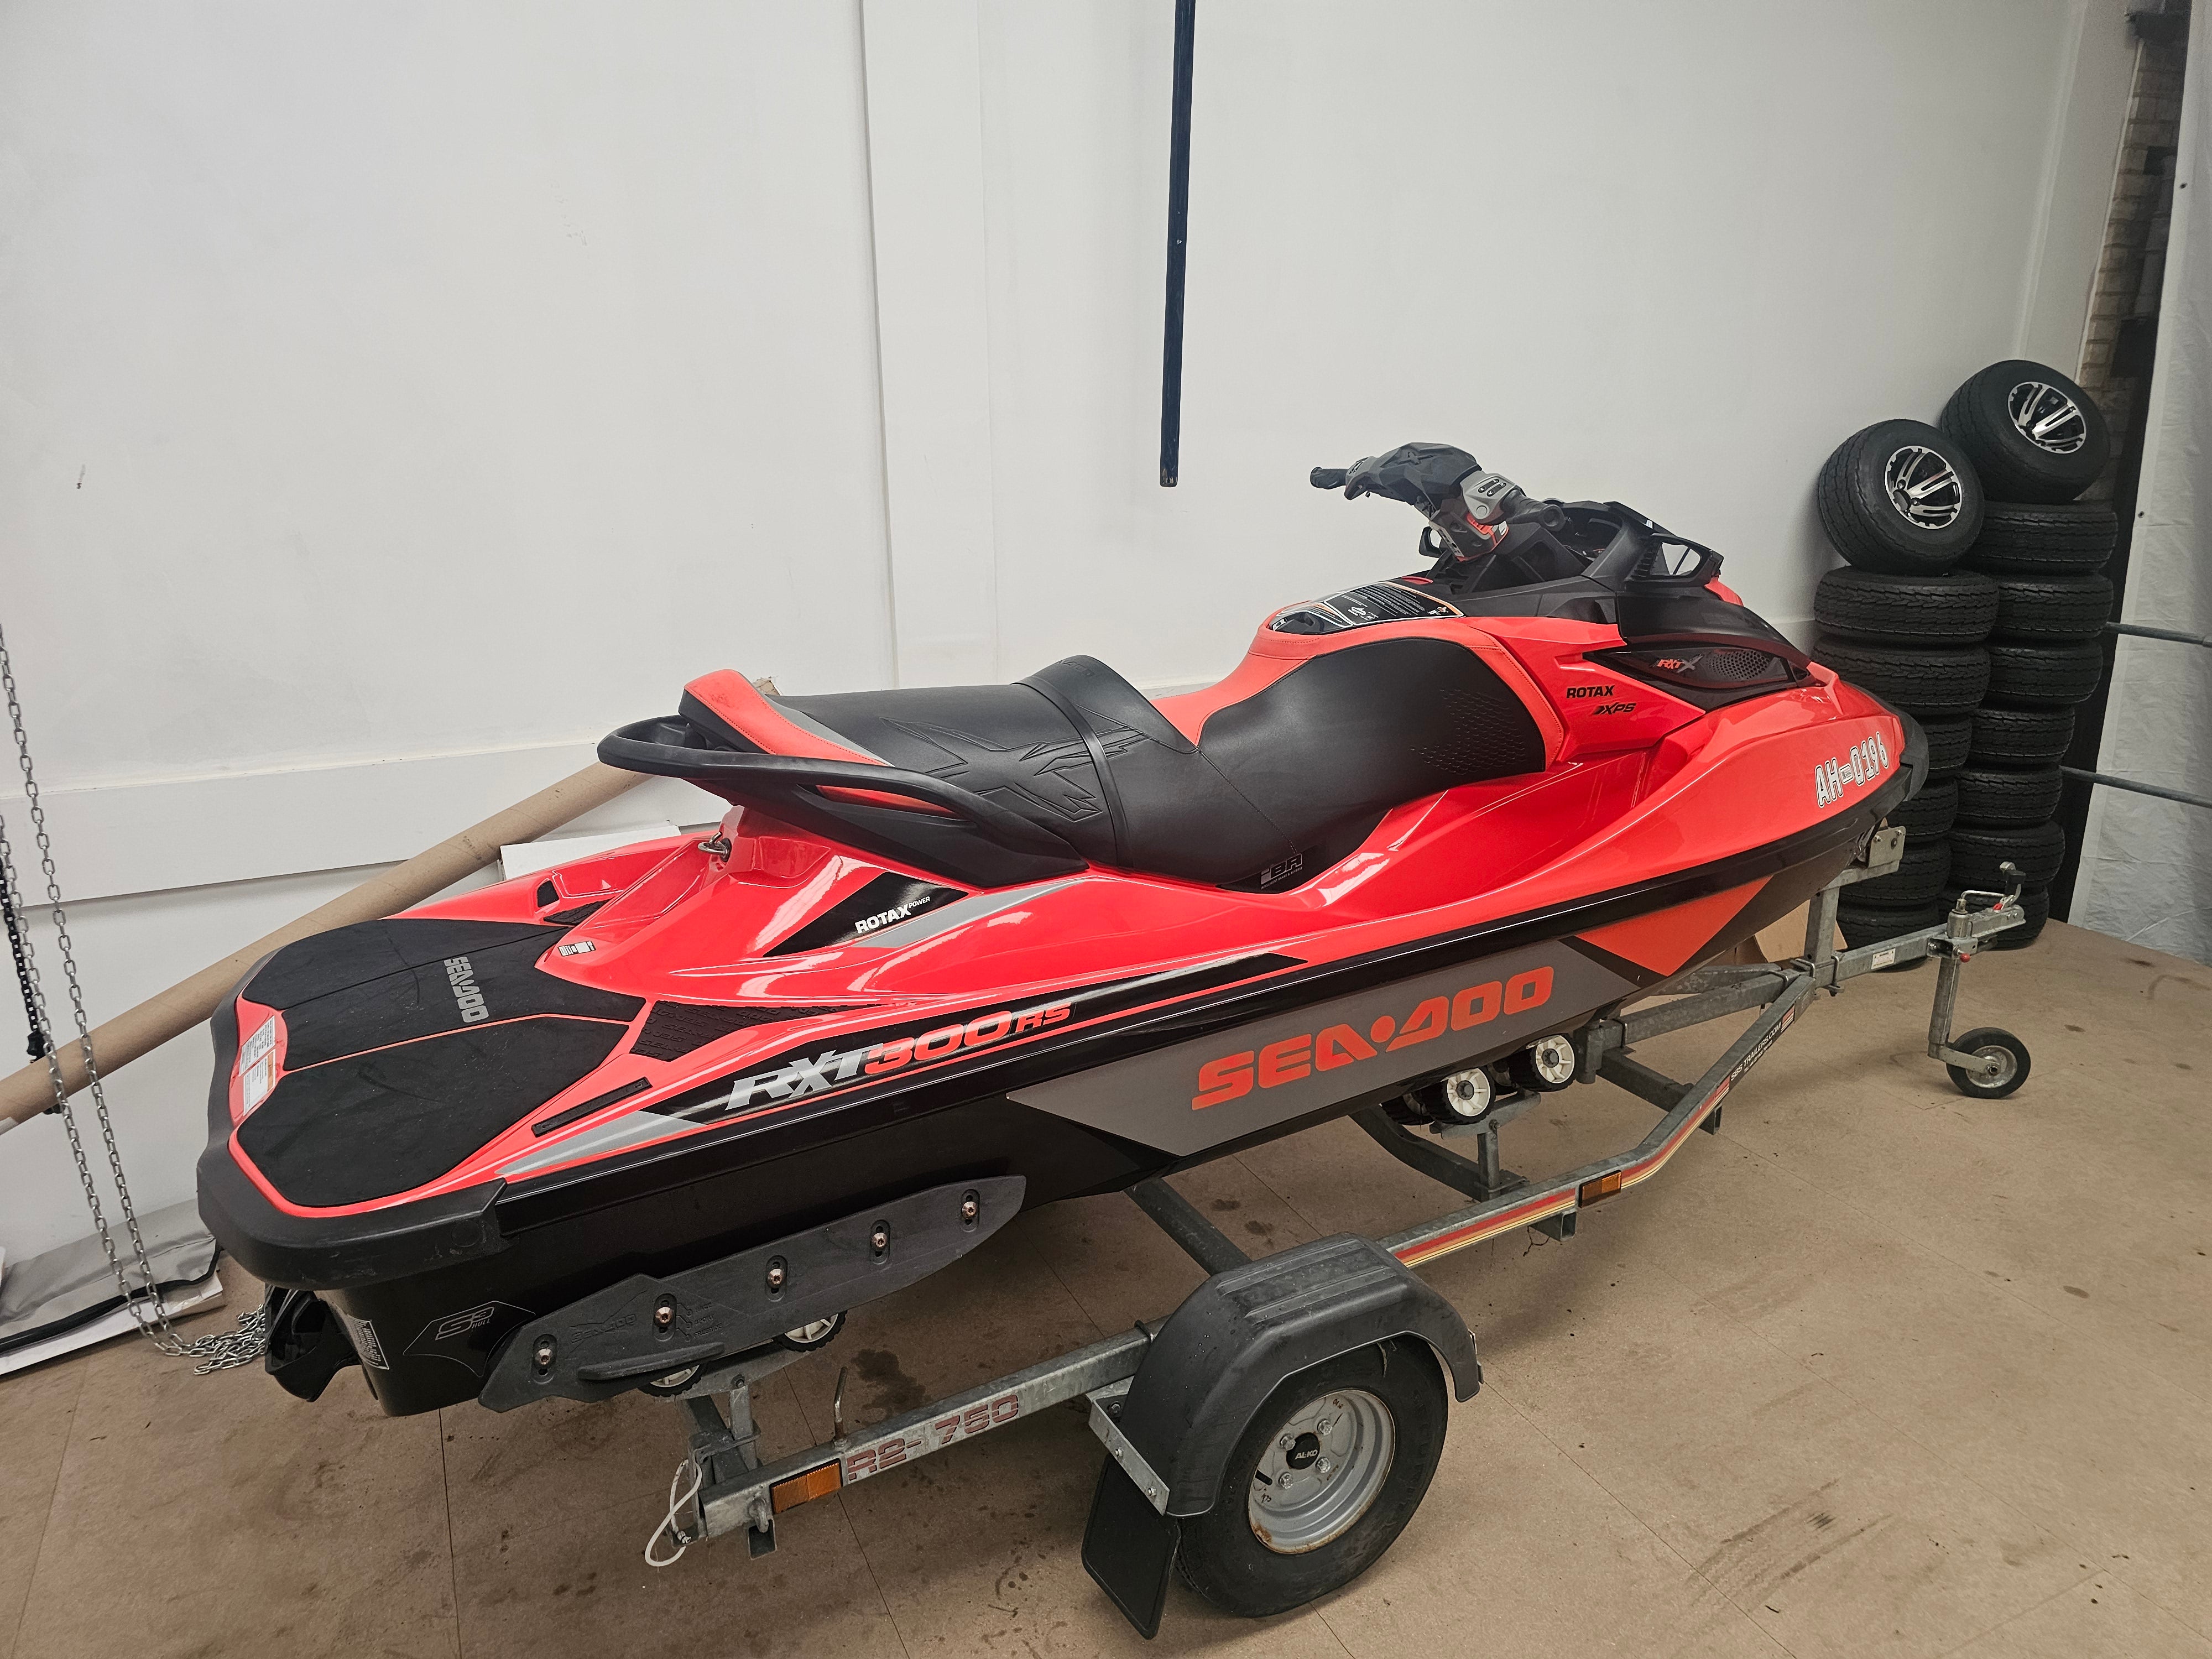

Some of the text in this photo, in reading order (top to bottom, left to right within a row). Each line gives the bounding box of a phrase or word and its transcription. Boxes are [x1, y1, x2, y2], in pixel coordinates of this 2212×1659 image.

[1566, 685, 1615, 698] ROTAX
[1593, 702, 1637, 715] XPS
[1815, 732, 1888, 808] AH-0196
[854, 896, 930, 934] ROTAX POWER
[1731, 1063, 1743, 1081] SBS
[1744, 1021, 1781, 1067] TRAILERS.COM
[472, 1318, 491, 1329] HULL
[935, 1394, 1019, 1445] 750
[1295, 1449, 1318, 1460] AL-KO
